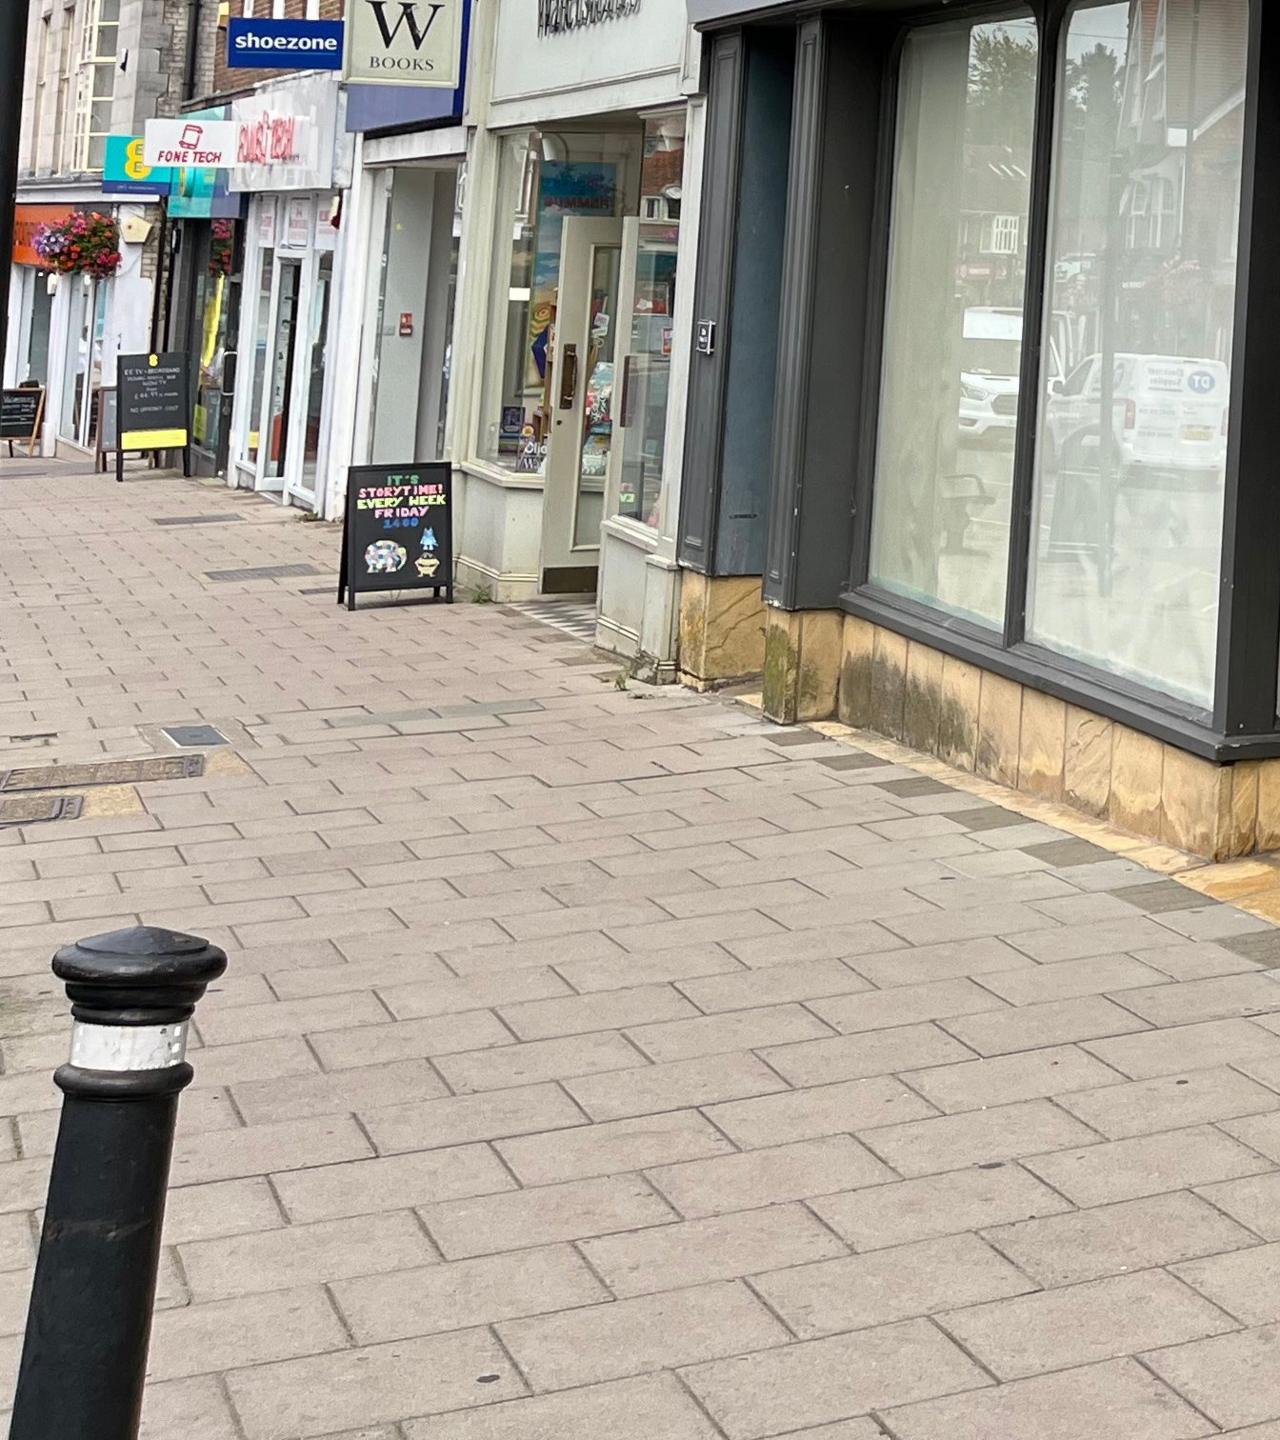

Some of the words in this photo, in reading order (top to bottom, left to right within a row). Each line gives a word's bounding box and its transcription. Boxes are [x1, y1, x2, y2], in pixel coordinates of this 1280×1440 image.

[365, 0, 446, 50] W
[235, 32, 338, 50] shoezone
[370, 56, 434, 71] BOOKS
[158, 151, 188, 163] FONE
[193, 151, 222, 164] TECH
[359, 484, 443, 498] STORYTIME!
[357, 496, 403, 509] EVERY
[409, 495, 446, 506] WEEK
[374, 506, 429, 518] FRIDAY
